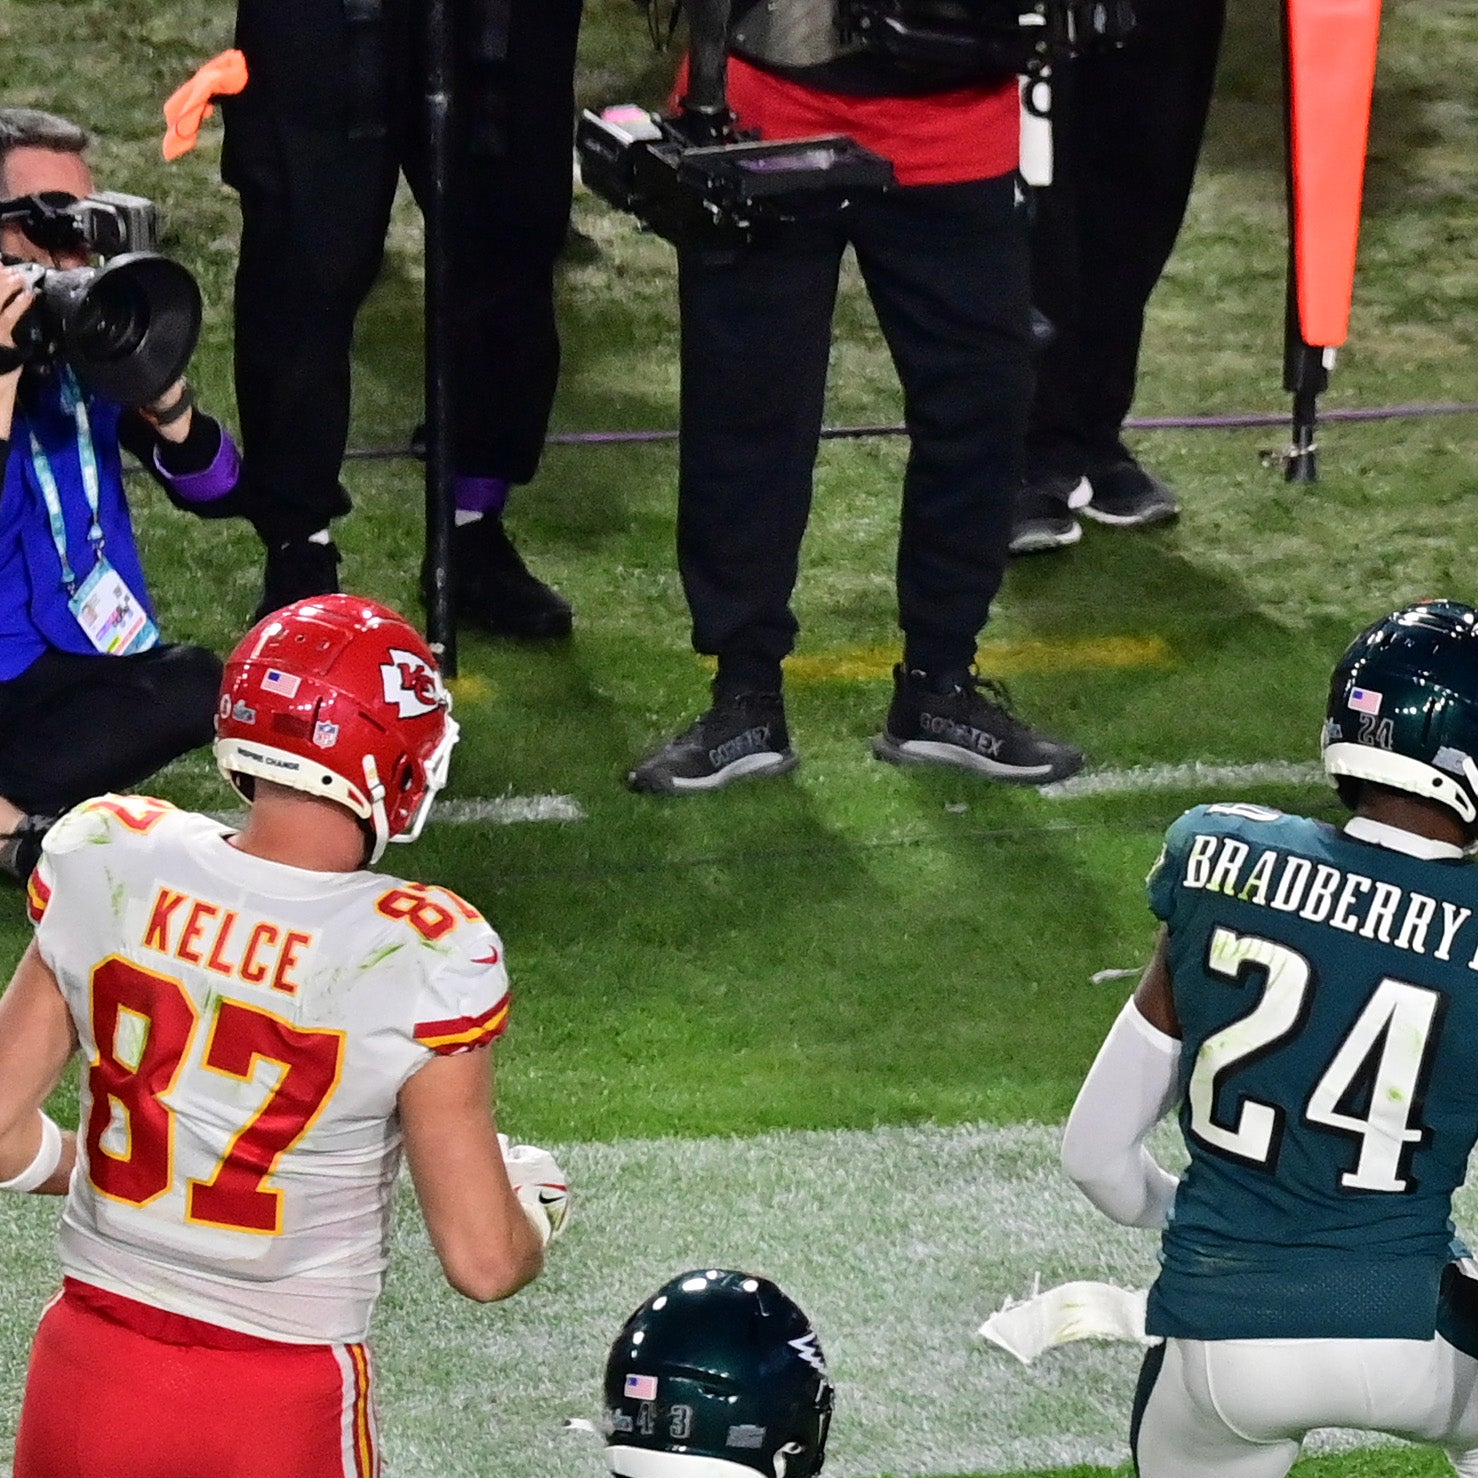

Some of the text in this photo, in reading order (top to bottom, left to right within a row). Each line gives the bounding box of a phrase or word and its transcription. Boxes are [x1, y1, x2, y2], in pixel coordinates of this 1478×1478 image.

[1357, 713, 1394, 750] 24
[141, 884, 313, 996] KELCE
[1182, 833, 1472, 961] BRADBERRY
[87, 951, 348, 1236] 87
[1188, 926, 1443, 1194] 24
[637, 1401, 693, 1439] 43
